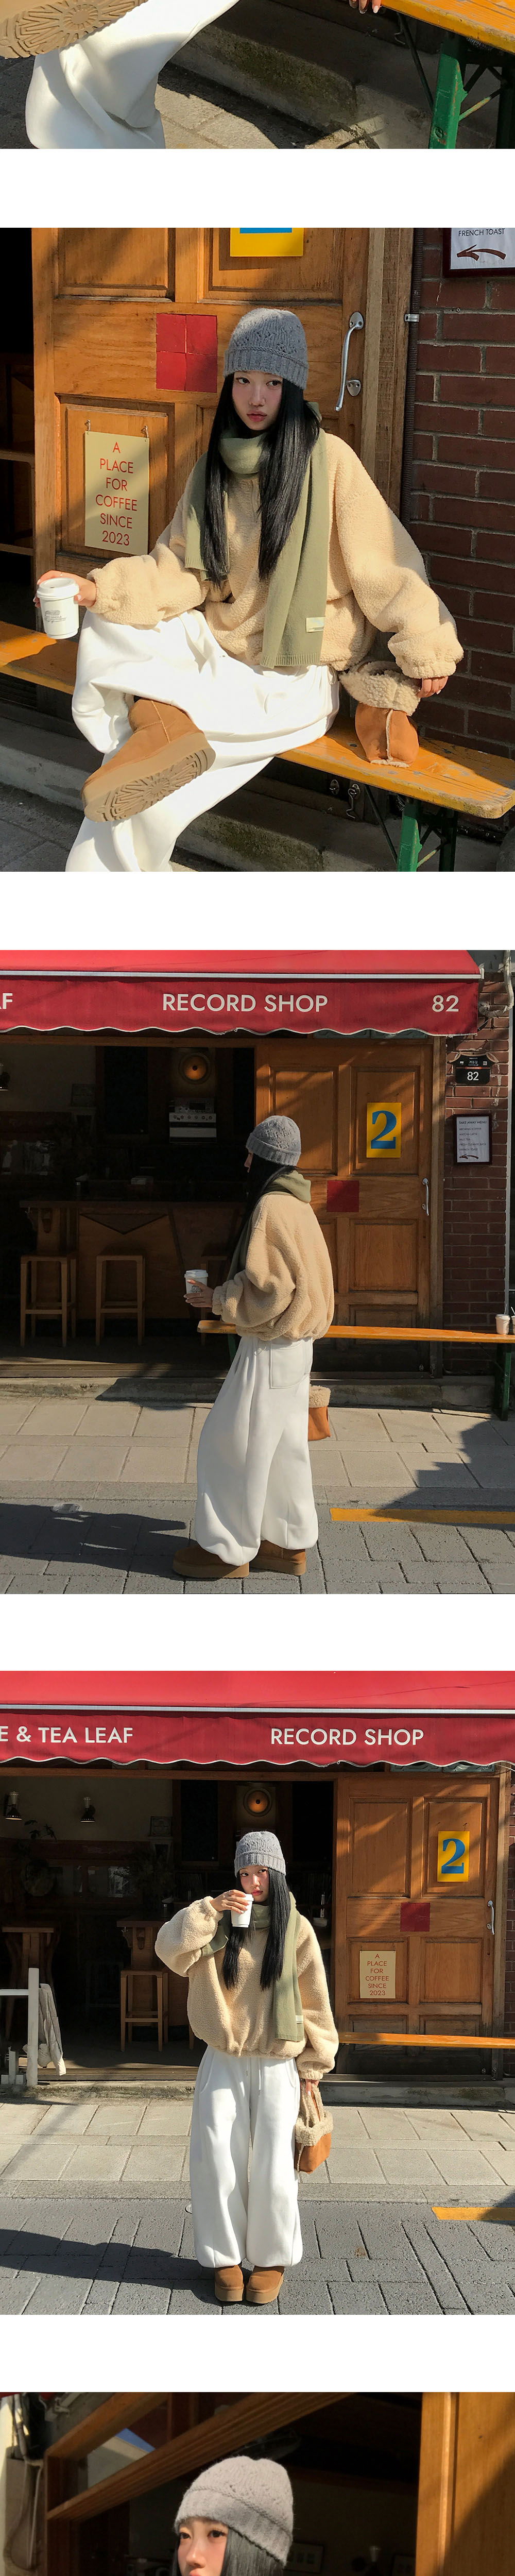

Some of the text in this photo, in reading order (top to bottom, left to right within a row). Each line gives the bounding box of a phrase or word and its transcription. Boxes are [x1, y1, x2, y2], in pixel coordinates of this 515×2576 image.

[112, 442, 121, 453] A
[100, 458, 134, 473] PLACE
[106, 477, 128, 491] FOR
[95, 494, 138, 511] COFFEE
[100, 513, 132, 529] SINCE
[102, 530, 130, 546] 2023
[0, 993, 13, 1009] F
[163, 993, 328, 1012] RECORD SHOP
[432, 995, 459, 1012] 82
[467, 1072, 479, 1081] 82
[371, 1110, 397, 1149] 2
[16, 1726, 31, 1742] &
[38, 1727, 77, 1743] TEA
[85, 1727, 133, 1743] LEAF
[271, 1728, 424, 1745] RECORD SHOP
[441, 1838, 466, 1874] 2
